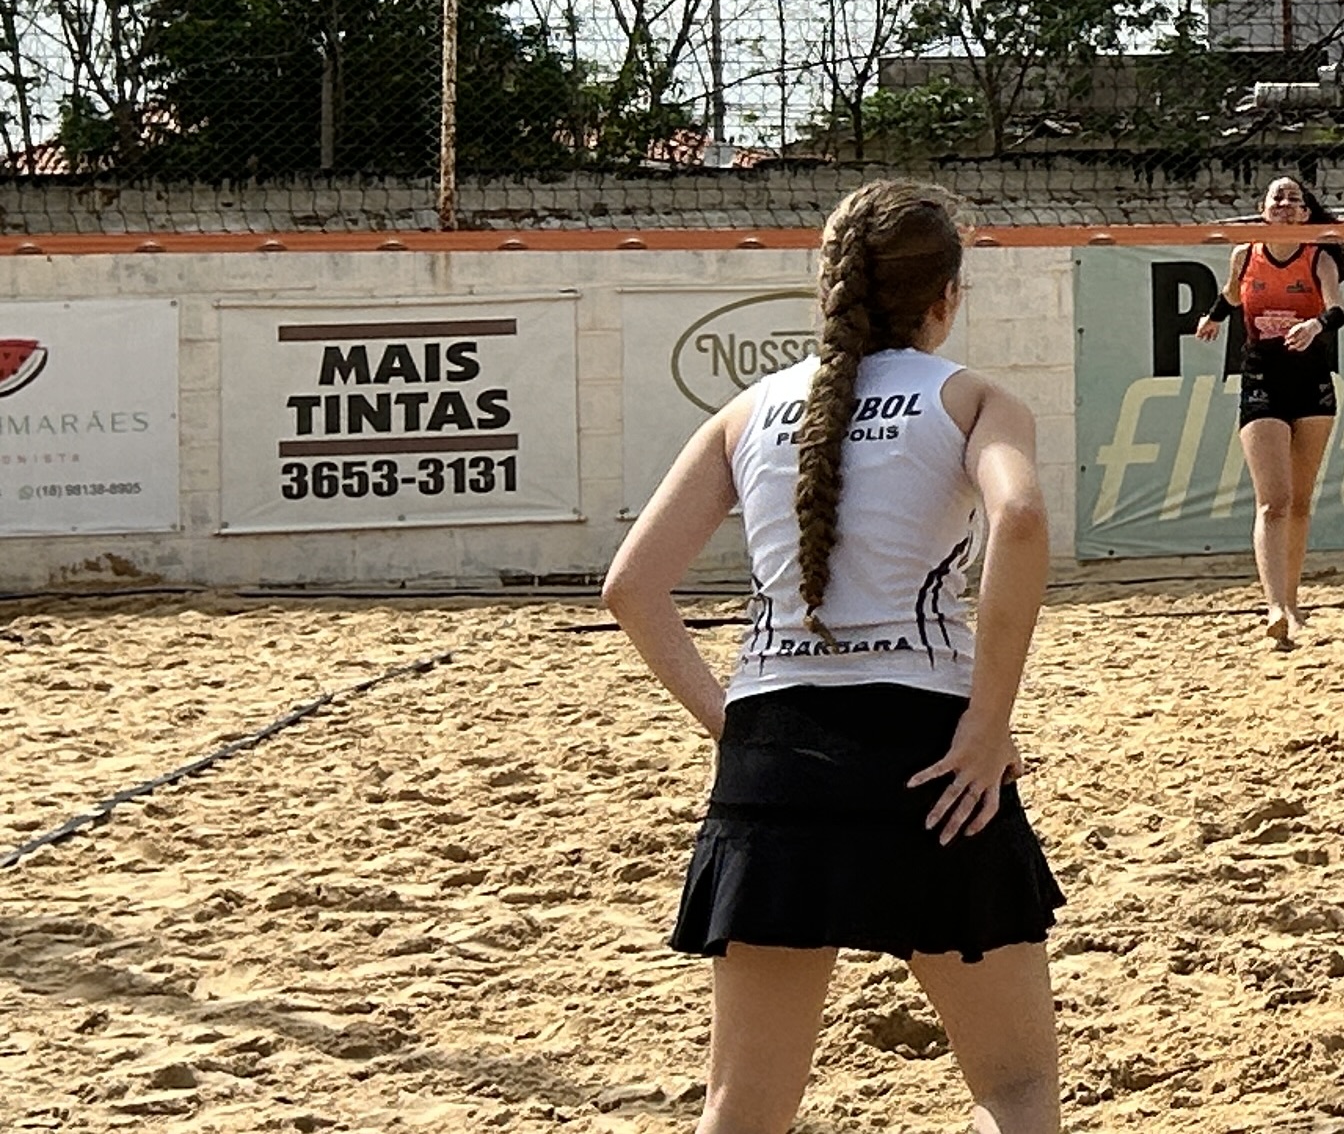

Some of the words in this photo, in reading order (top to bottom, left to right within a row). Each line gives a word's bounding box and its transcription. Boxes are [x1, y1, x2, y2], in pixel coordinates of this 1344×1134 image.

[318, 341, 481, 386] MAIS
[287, 389, 511, 435] TINTAS
[762, 392, 922, 430] VOBOL
[776, 424, 899, 446] PEOLIS
[281, 455, 518, 500] 3653-3131
